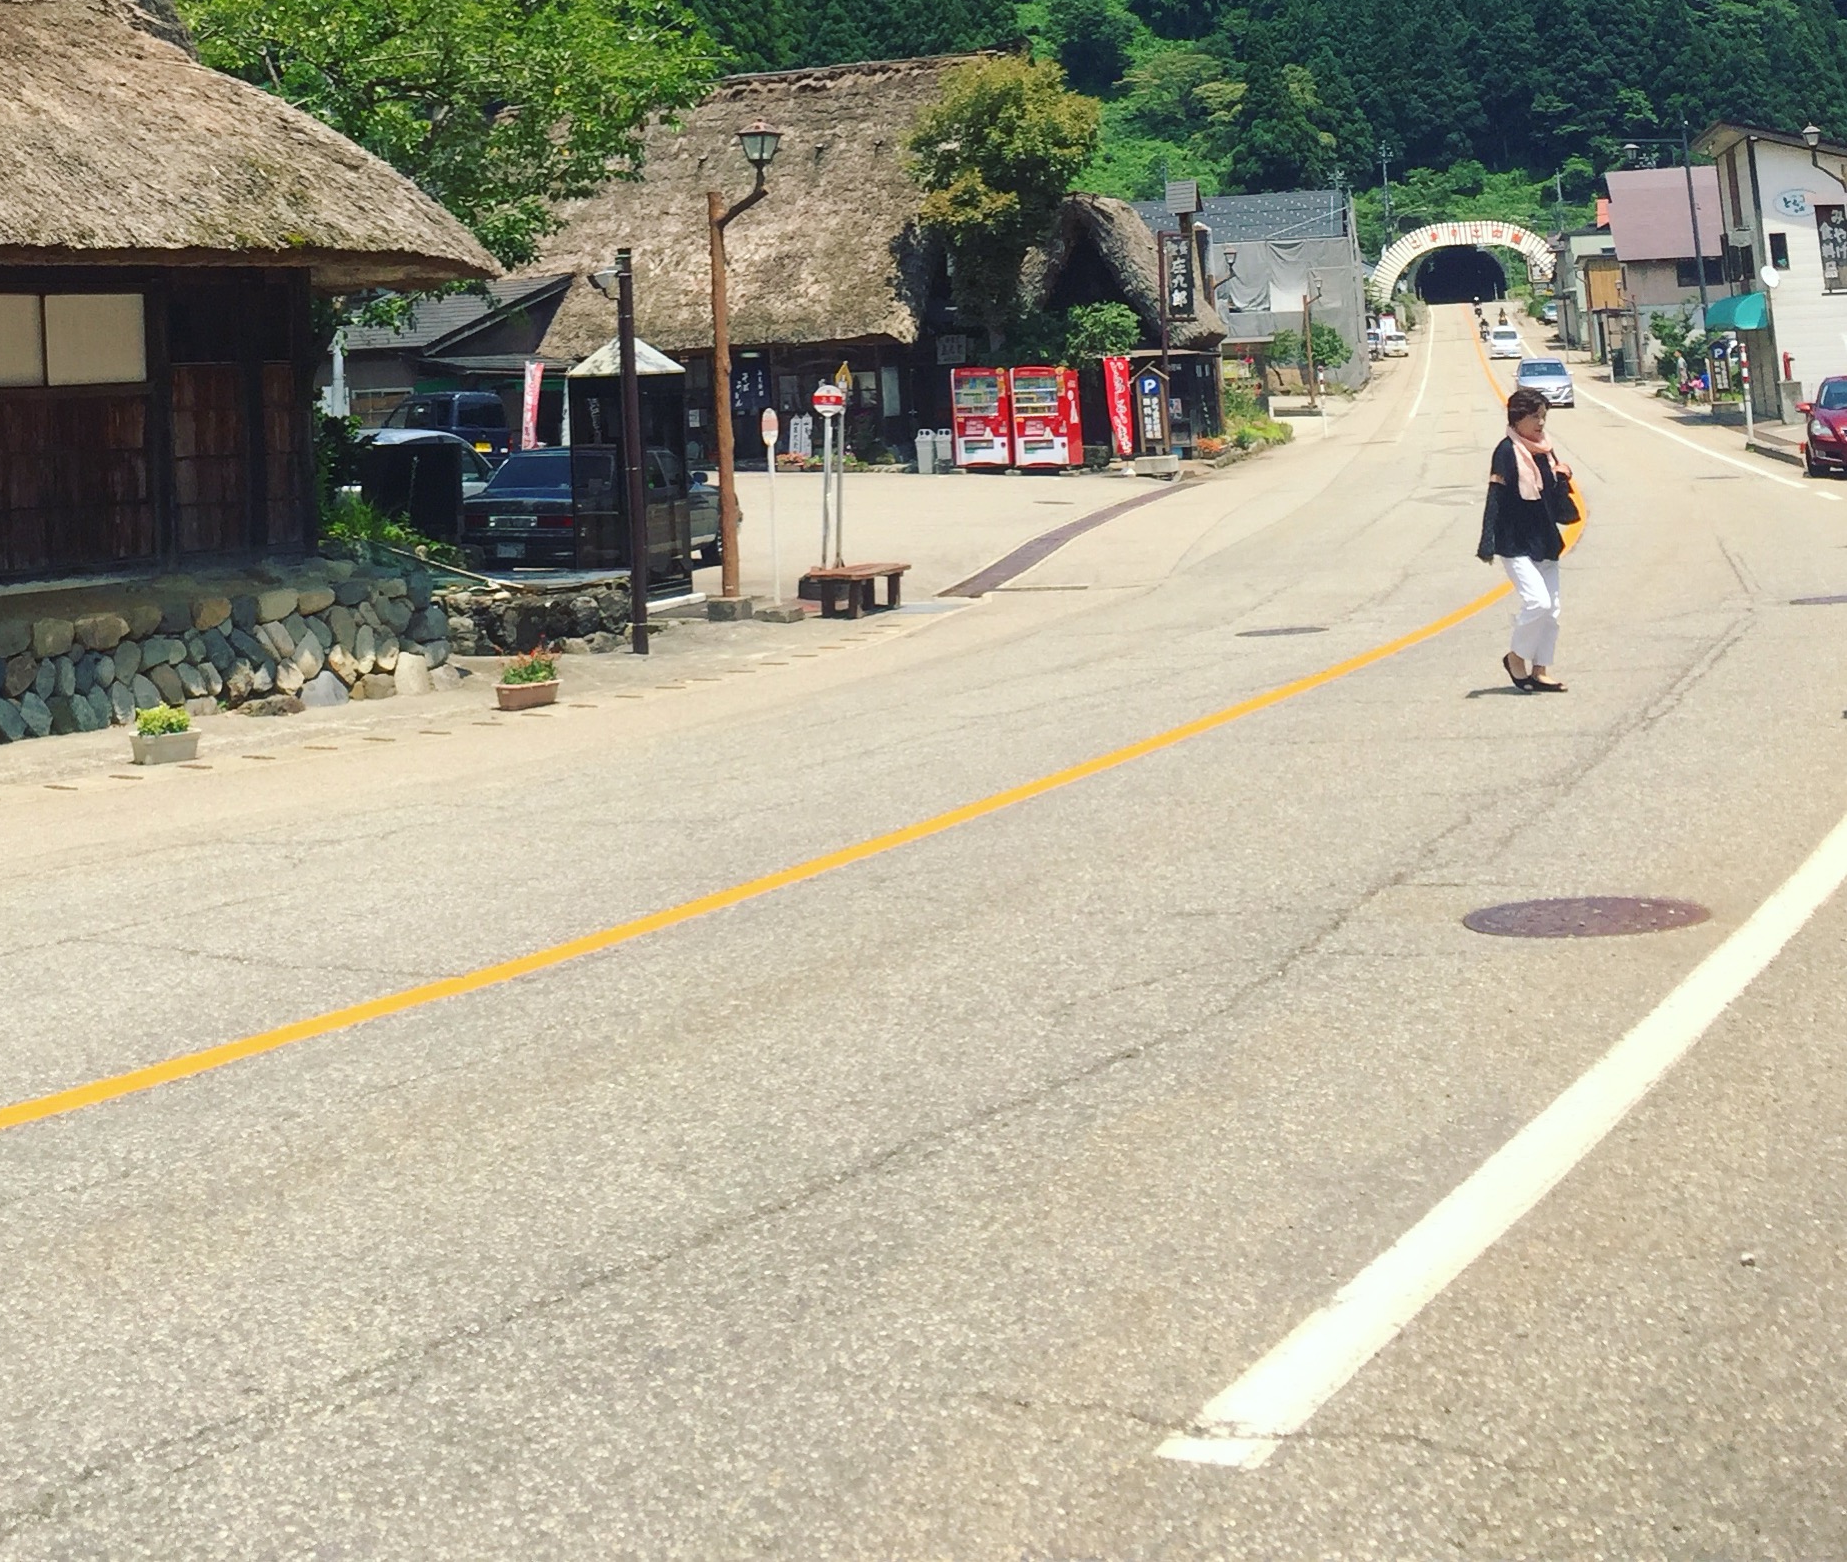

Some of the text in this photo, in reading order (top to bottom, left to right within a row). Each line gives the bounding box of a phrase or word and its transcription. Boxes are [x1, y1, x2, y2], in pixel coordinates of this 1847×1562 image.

[1172, 257, 1188, 308] 庄九郎
[1714, 348, 1723, 358] P
[1144, 379, 1157, 393] P
